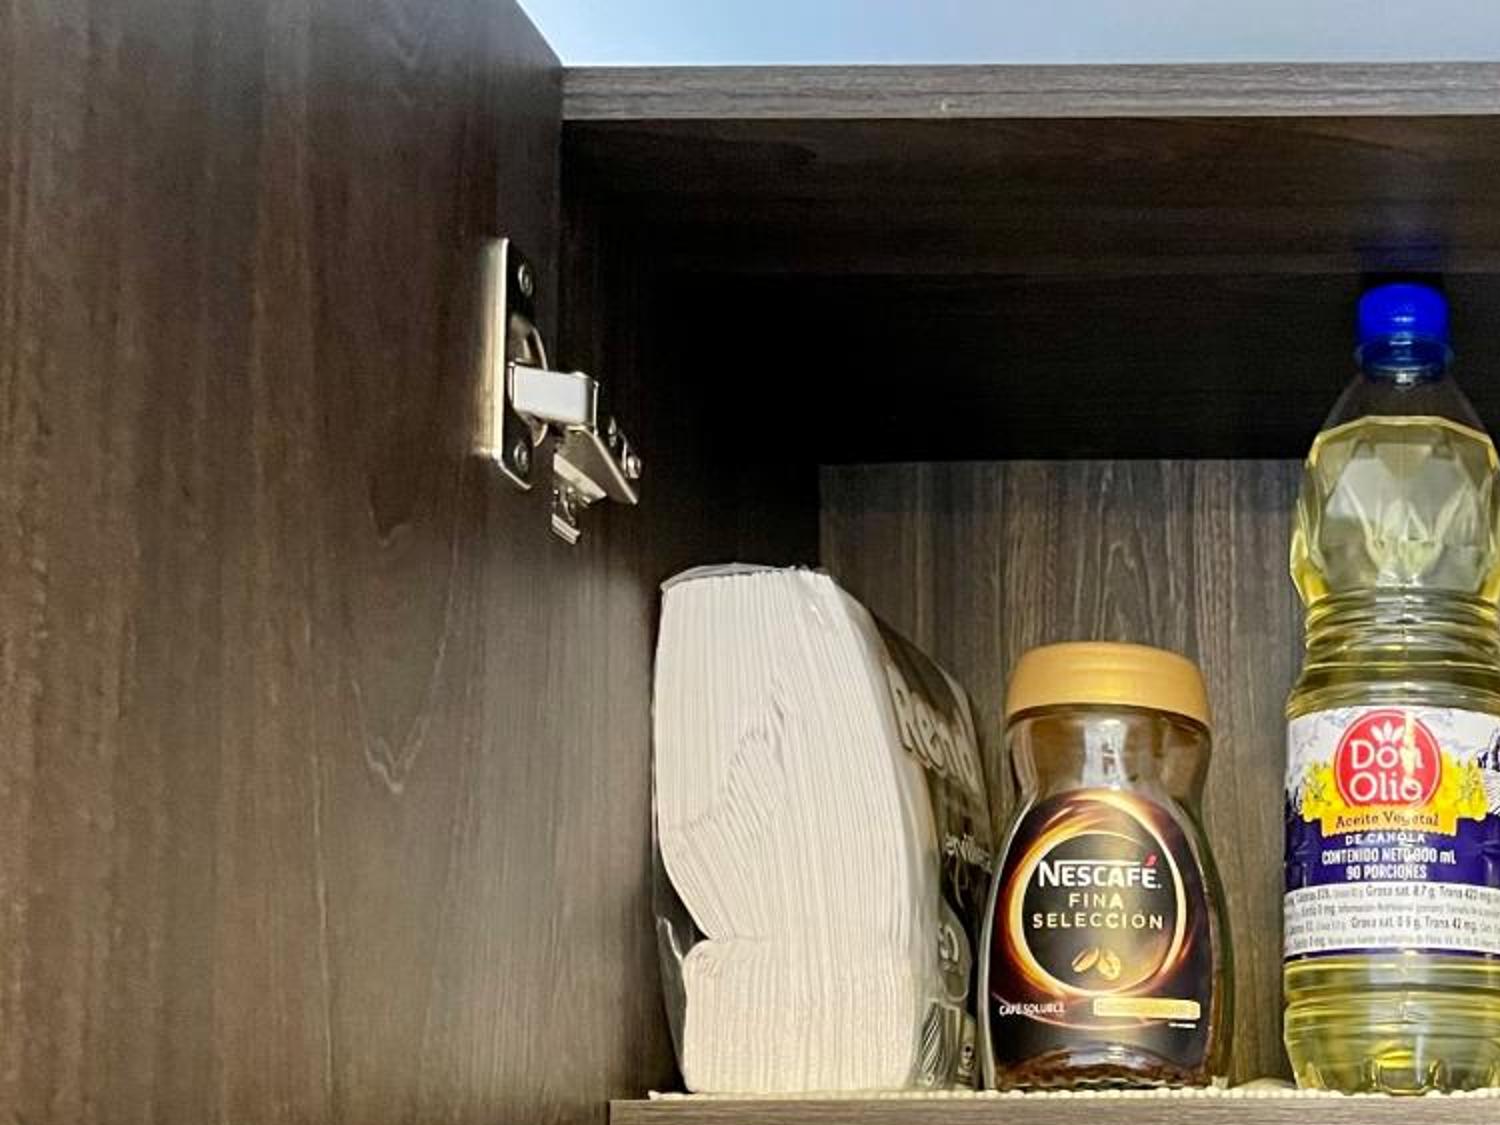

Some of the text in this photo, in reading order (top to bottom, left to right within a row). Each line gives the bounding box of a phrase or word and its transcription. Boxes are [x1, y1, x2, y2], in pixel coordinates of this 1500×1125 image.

[1351, 739, 1424, 769] Don
[1349, 771, 1423, 802] Olio
[1336, 814, 1378, 829] Aceite
[1345, 834, 1362, 846] DE
[1321, 847, 1379, 866] CONTENIDO
[1381, 847, 1411, 863] NETO
[1038, 852, 1160, 889] NESCAFÉ
[1345, 863, 1427, 880] 90 PORCIONES
[1068, 892, 1124, 910] FINA
